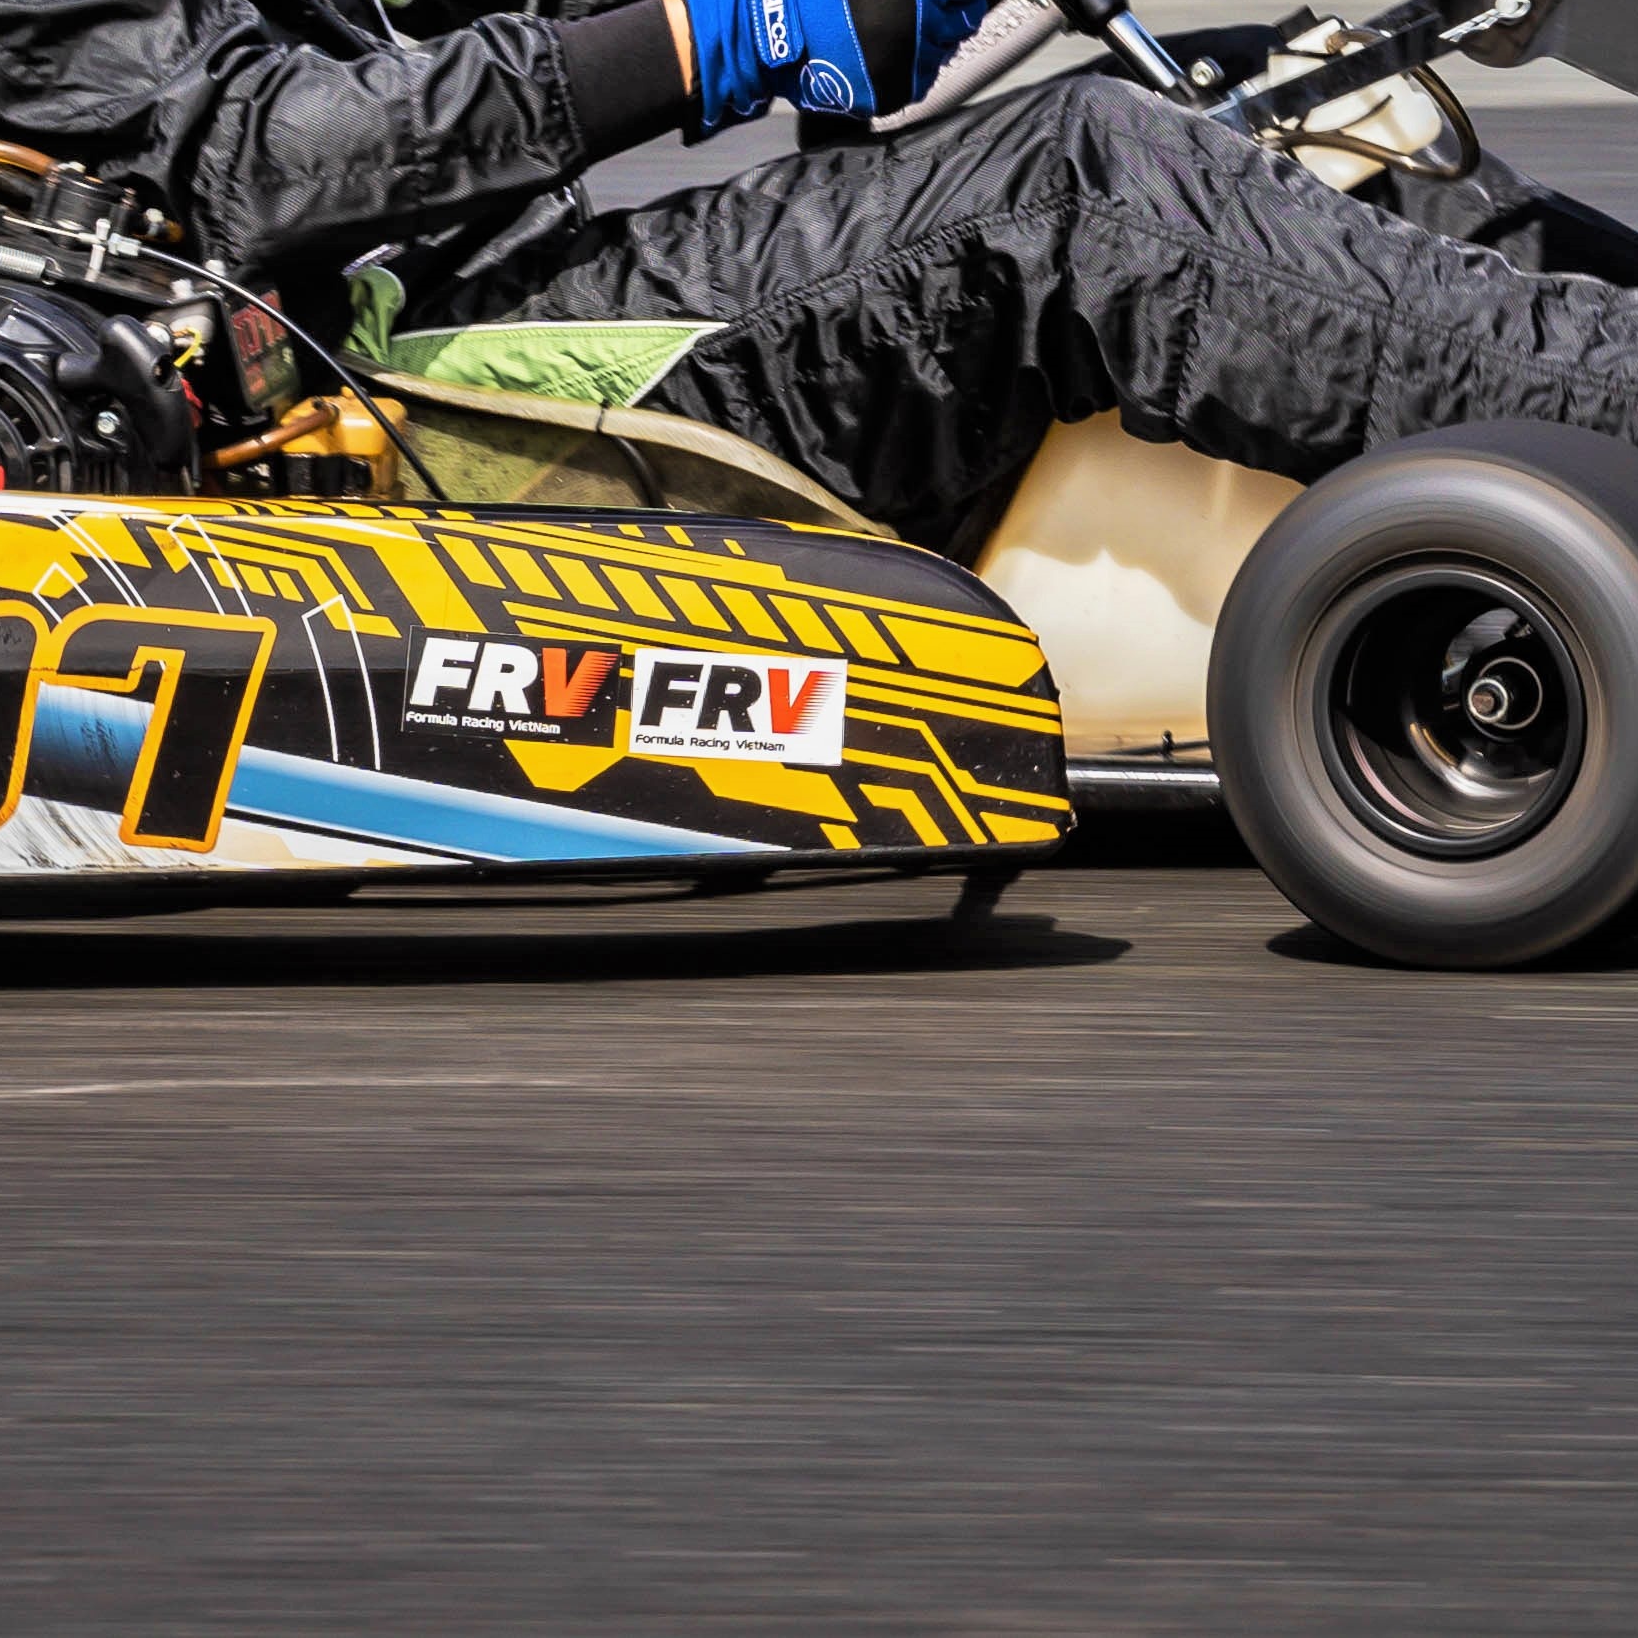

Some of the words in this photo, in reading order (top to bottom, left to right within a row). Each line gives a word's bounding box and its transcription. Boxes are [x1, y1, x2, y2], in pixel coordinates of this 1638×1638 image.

[409, 637, 619, 718] FRV
[639, 661, 843, 735] FRV
[406, 711, 458, 727] Formula
[462, 716, 505, 732] Racing
[509, 720, 561, 735] VietNam
[635, 734, 684, 746] Formula
[690, 737, 730, 751] Racing
[736, 740, 786, 752] VietNam
